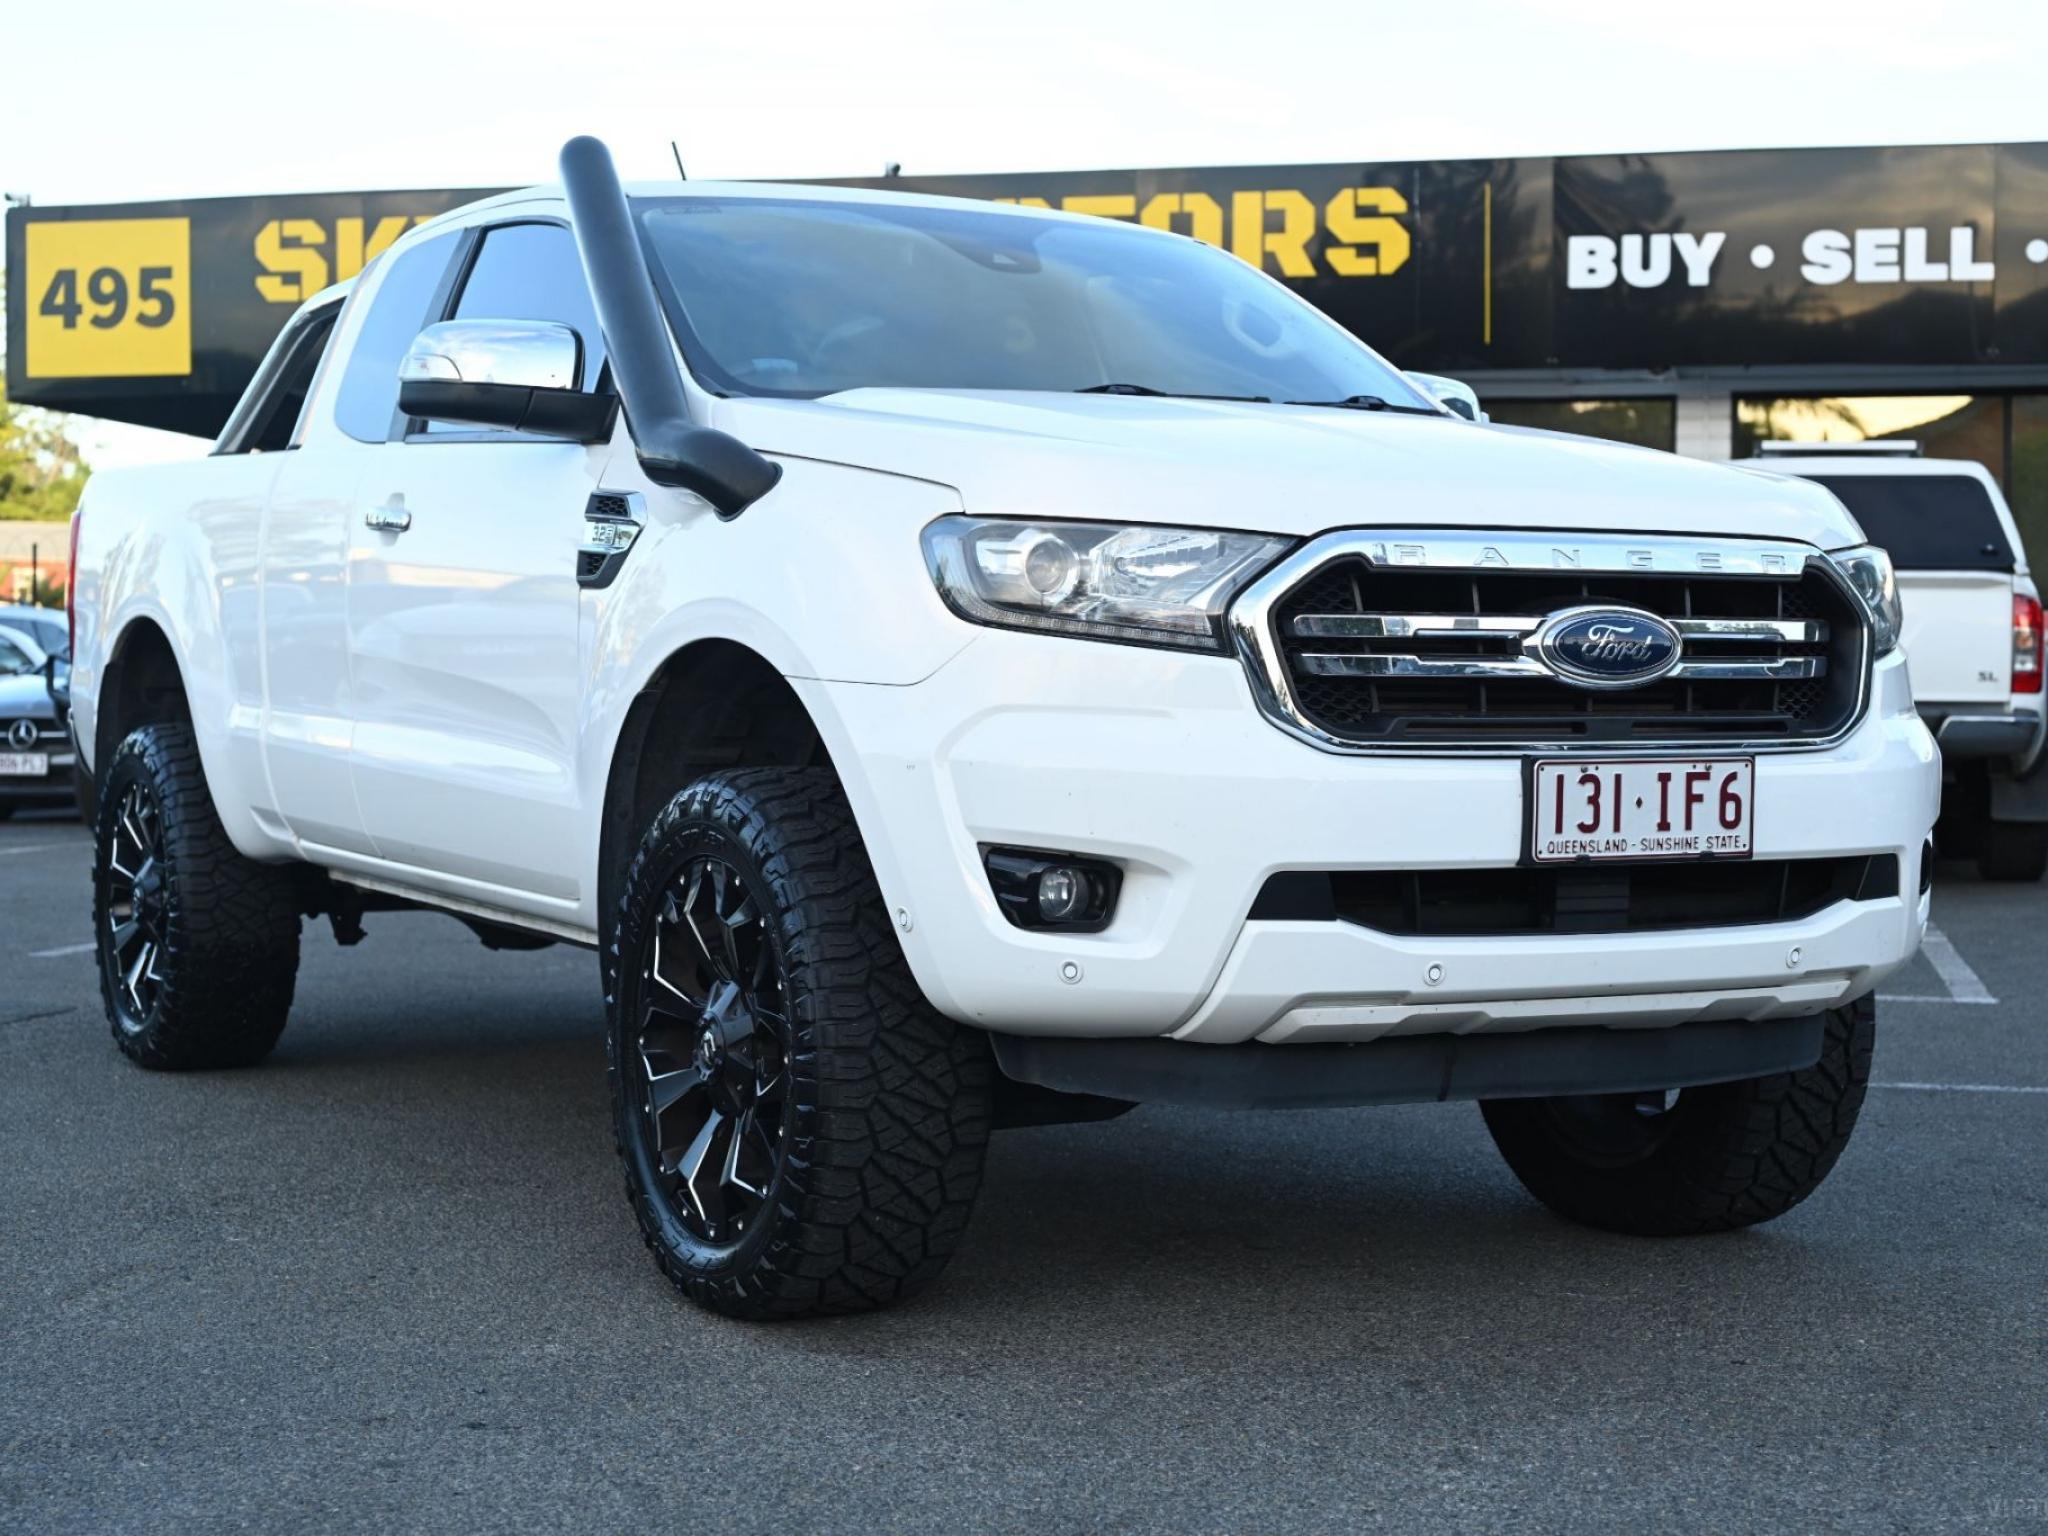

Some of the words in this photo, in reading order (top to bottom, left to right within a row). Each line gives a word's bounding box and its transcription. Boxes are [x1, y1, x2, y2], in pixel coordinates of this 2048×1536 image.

[254, 214, 438, 303] SK
[1567, 232, 1726, 289] BUY
[1800, 226, 1995, 285] SELL
[39, 265, 176, 330] 495
[1393, 543, 1787, 572] RANGER
[1581, 624, 1653, 661] Ford
[1546, 838, 1628, 855] QUEENSLAND
[1640, 836, 1699, 851] SUNSHINE
[1706, 835, 1740, 849] STATE
